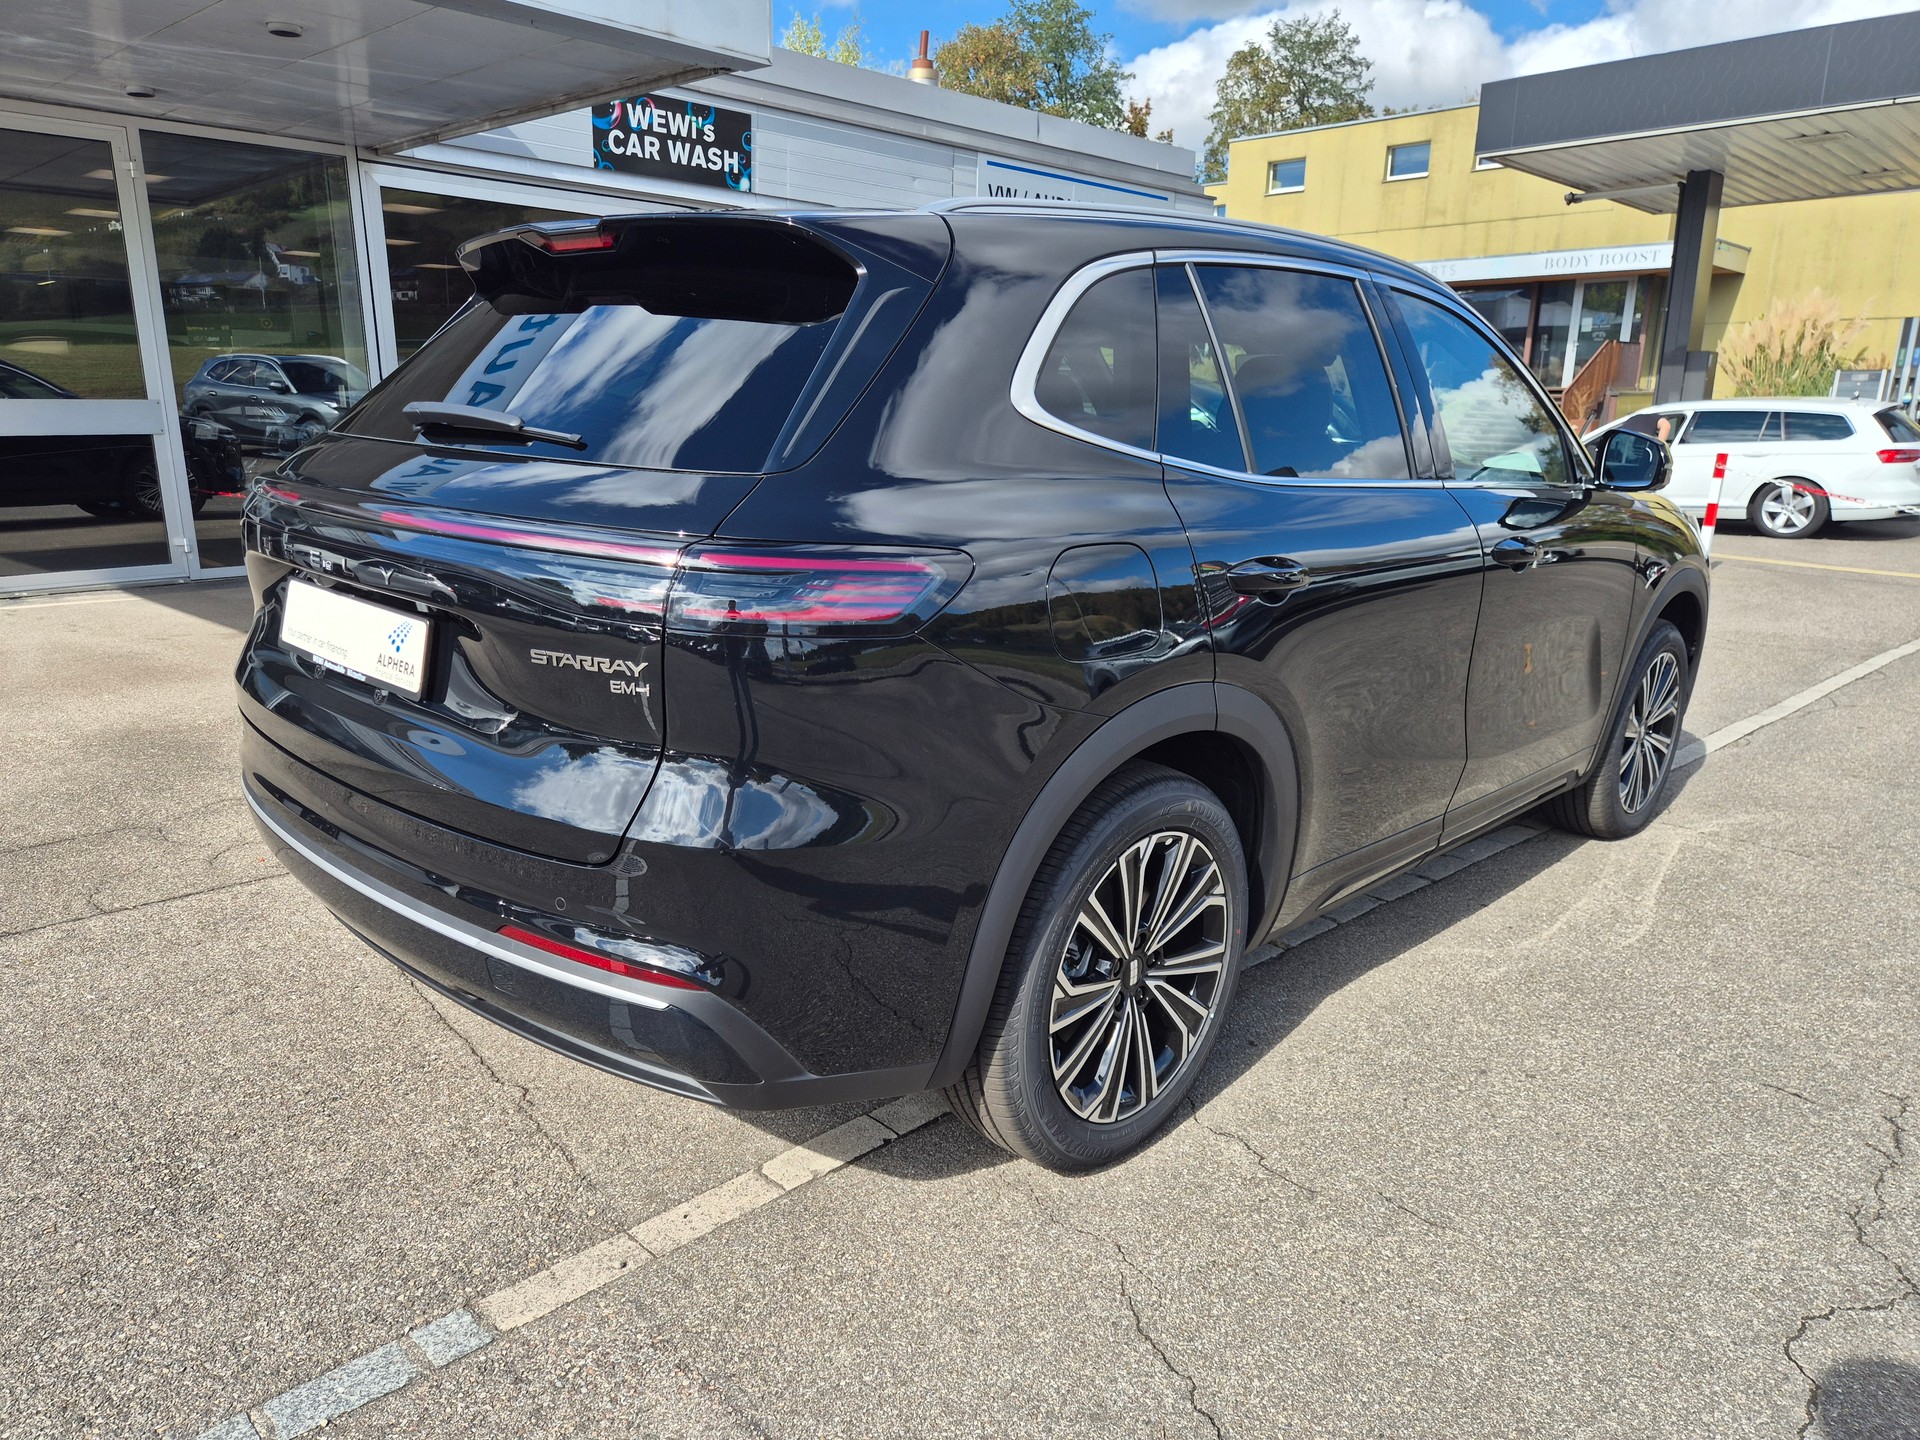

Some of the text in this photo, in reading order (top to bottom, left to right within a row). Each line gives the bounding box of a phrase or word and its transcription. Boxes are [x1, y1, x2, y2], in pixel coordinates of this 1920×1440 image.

[626, 102, 716, 143] WEWi's
[607, 129, 739, 174] CAR WASH
[1544, 249, 1662, 270] BODY BOOST
[376, 652, 415, 678] ALPHERA
[529, 648, 649, 678] STARRAY
